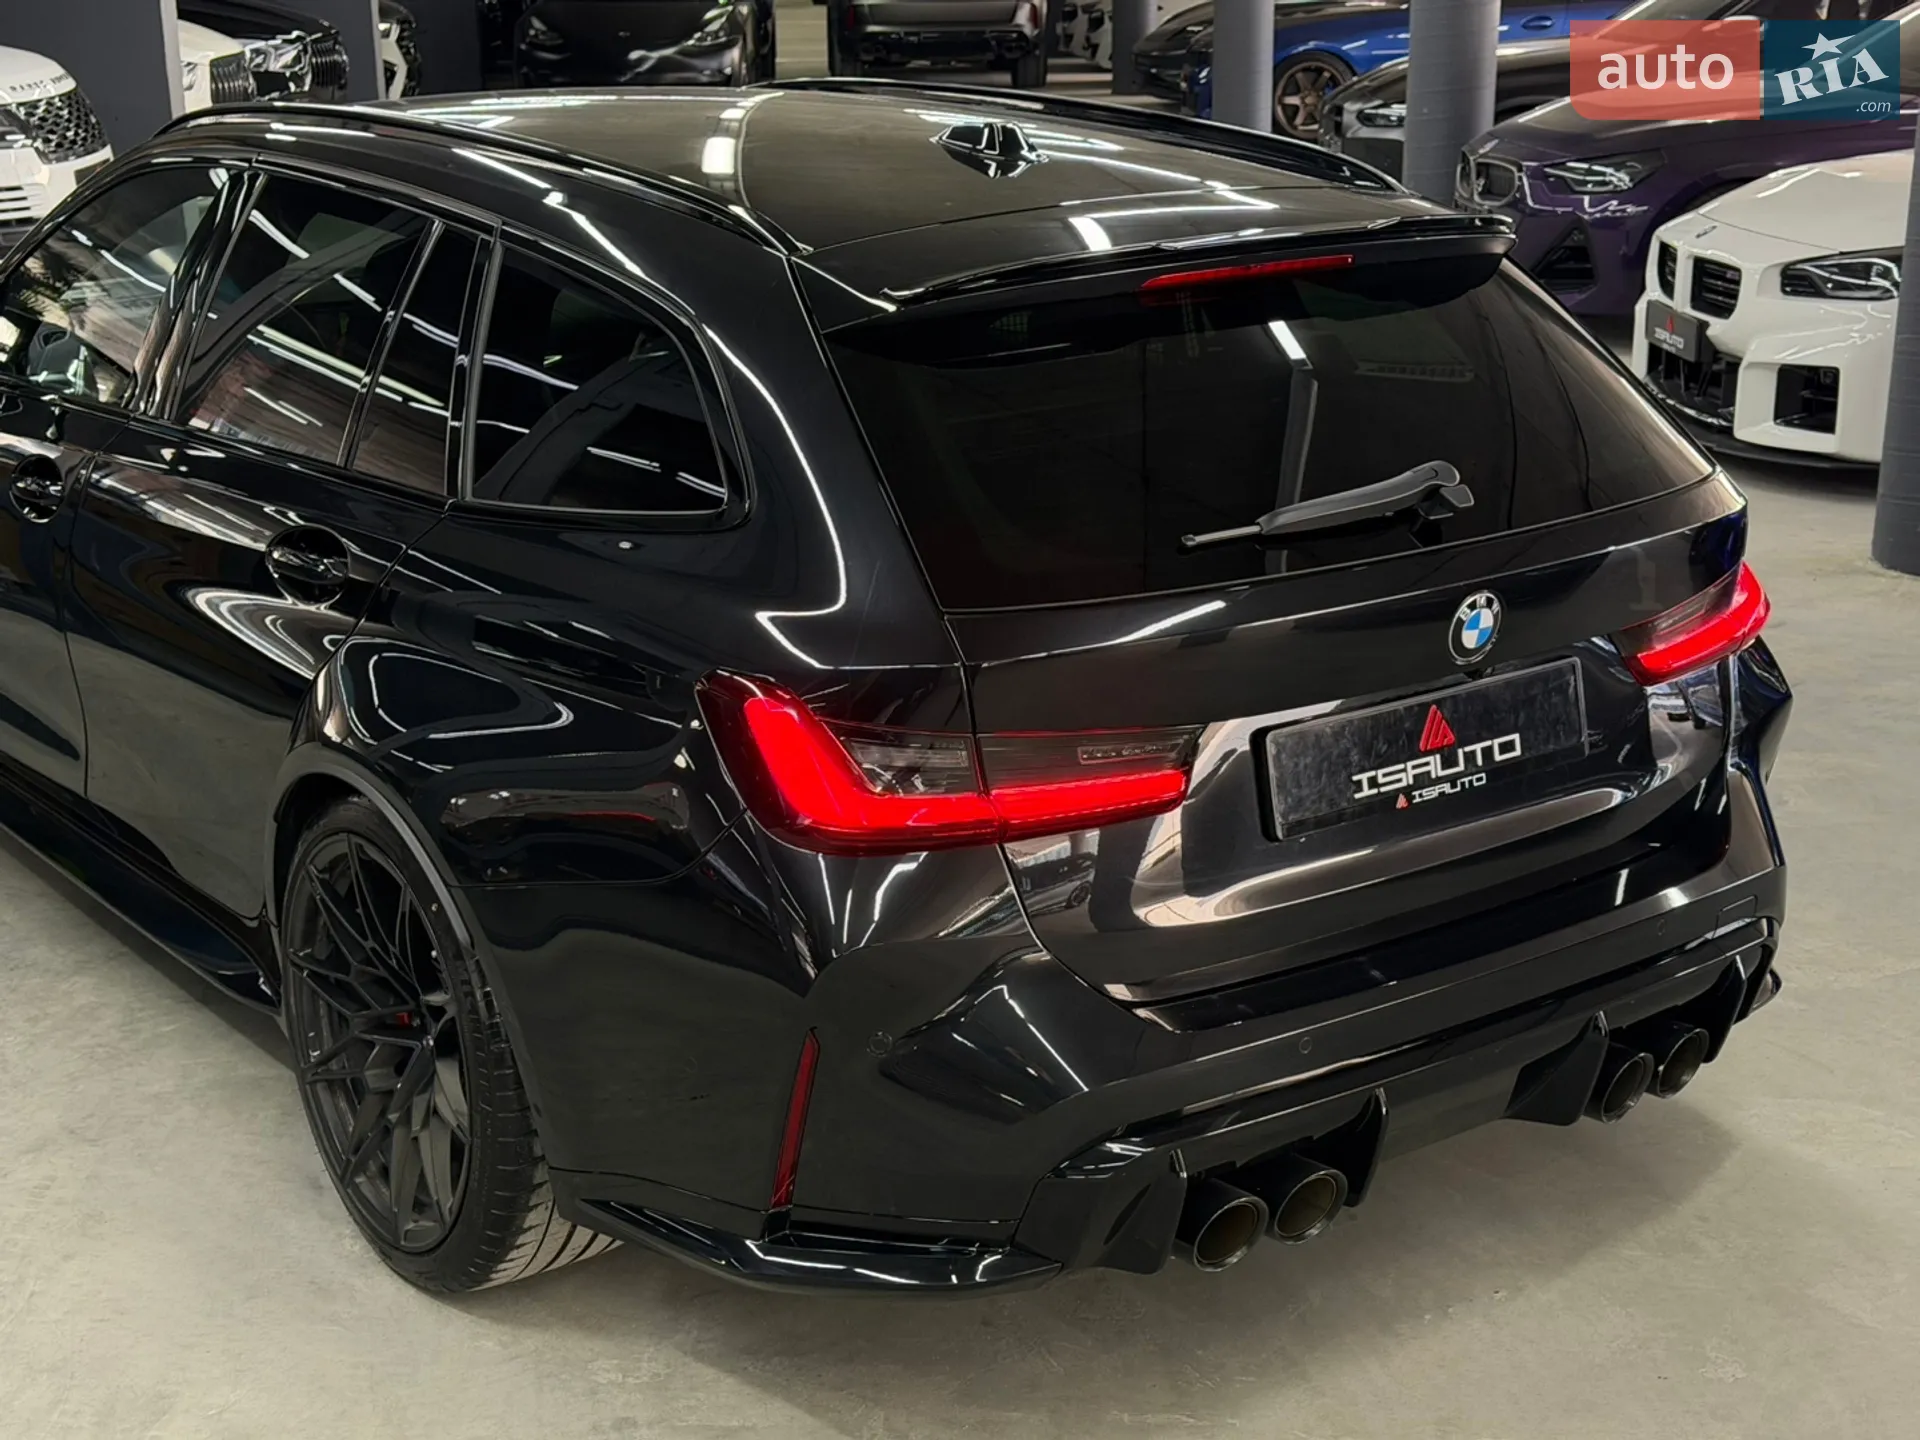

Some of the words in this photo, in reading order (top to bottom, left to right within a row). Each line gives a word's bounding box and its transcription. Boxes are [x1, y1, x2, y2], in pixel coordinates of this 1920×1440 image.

[1459, 595, 1501, 622] BMW
[1352, 733, 1522, 799] ISAUTO
[1411, 773, 1487, 803] ISAUTO
